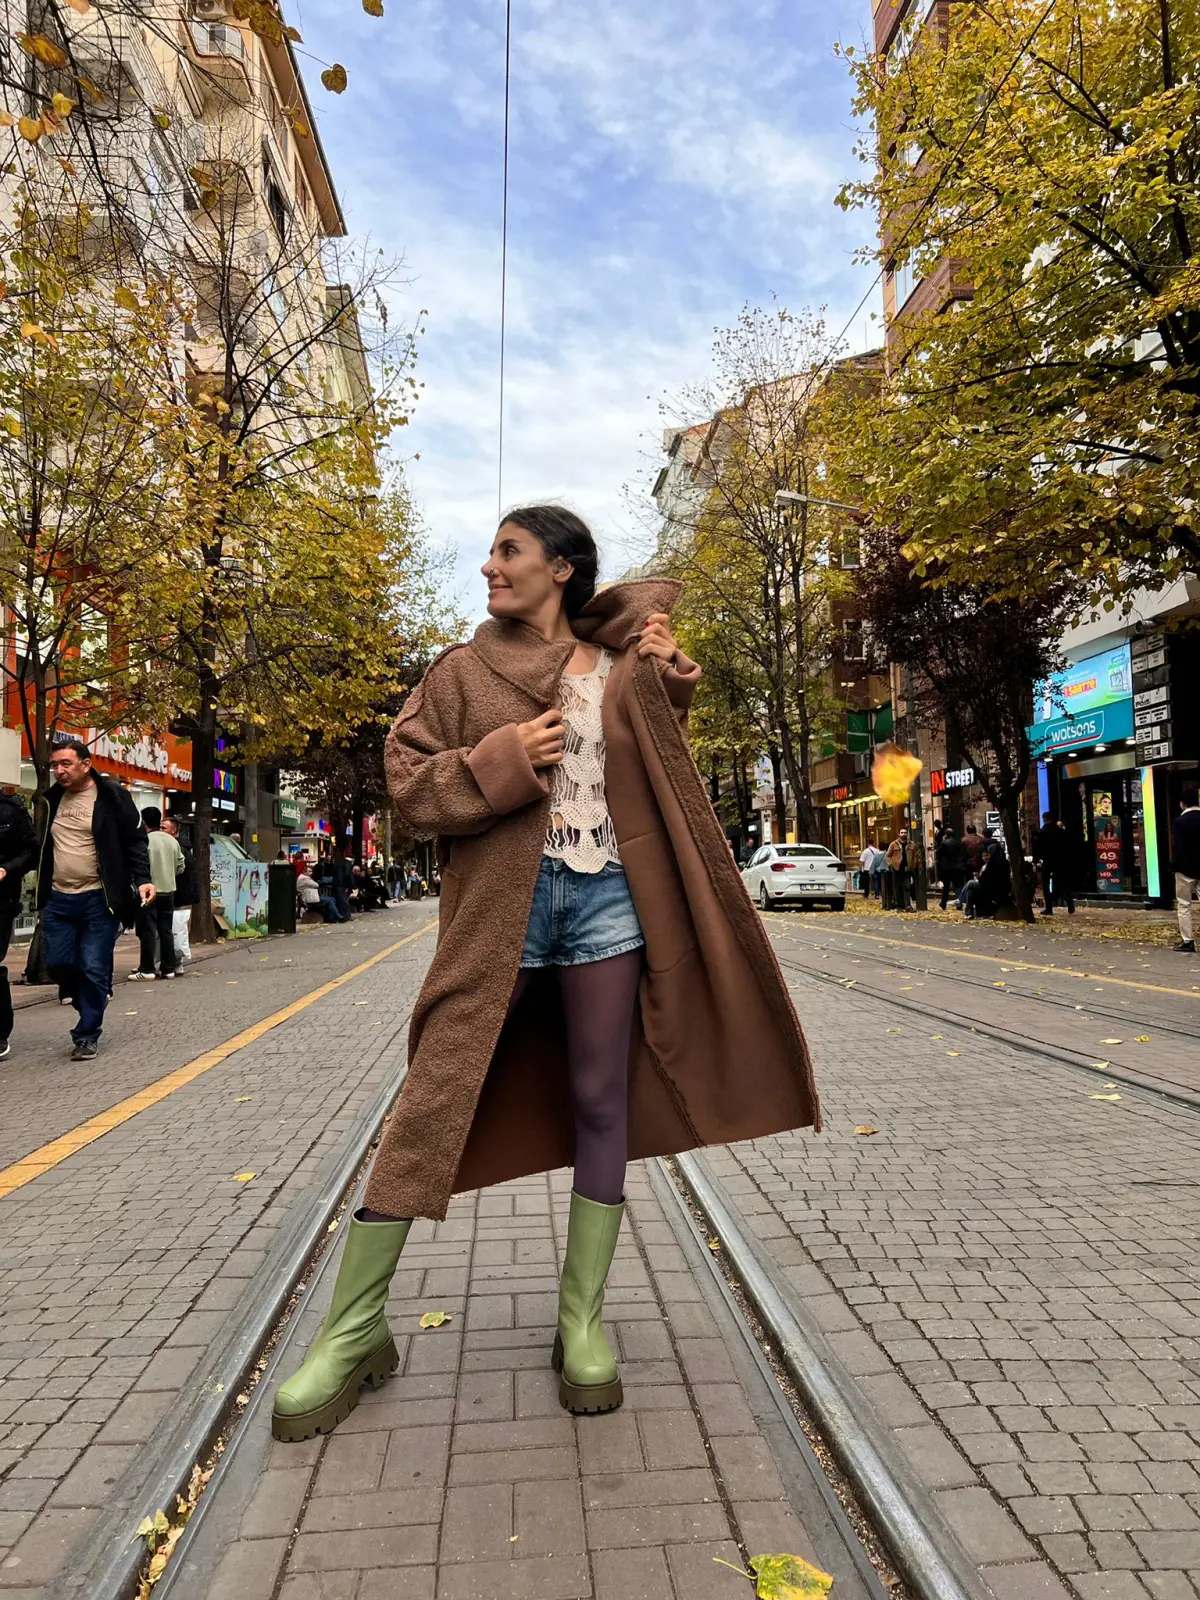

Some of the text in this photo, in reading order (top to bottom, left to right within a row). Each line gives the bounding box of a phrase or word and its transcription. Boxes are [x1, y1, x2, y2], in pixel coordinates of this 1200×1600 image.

[1051, 720, 1096, 742] watsons
[931, 768, 974, 794] IN STREET
